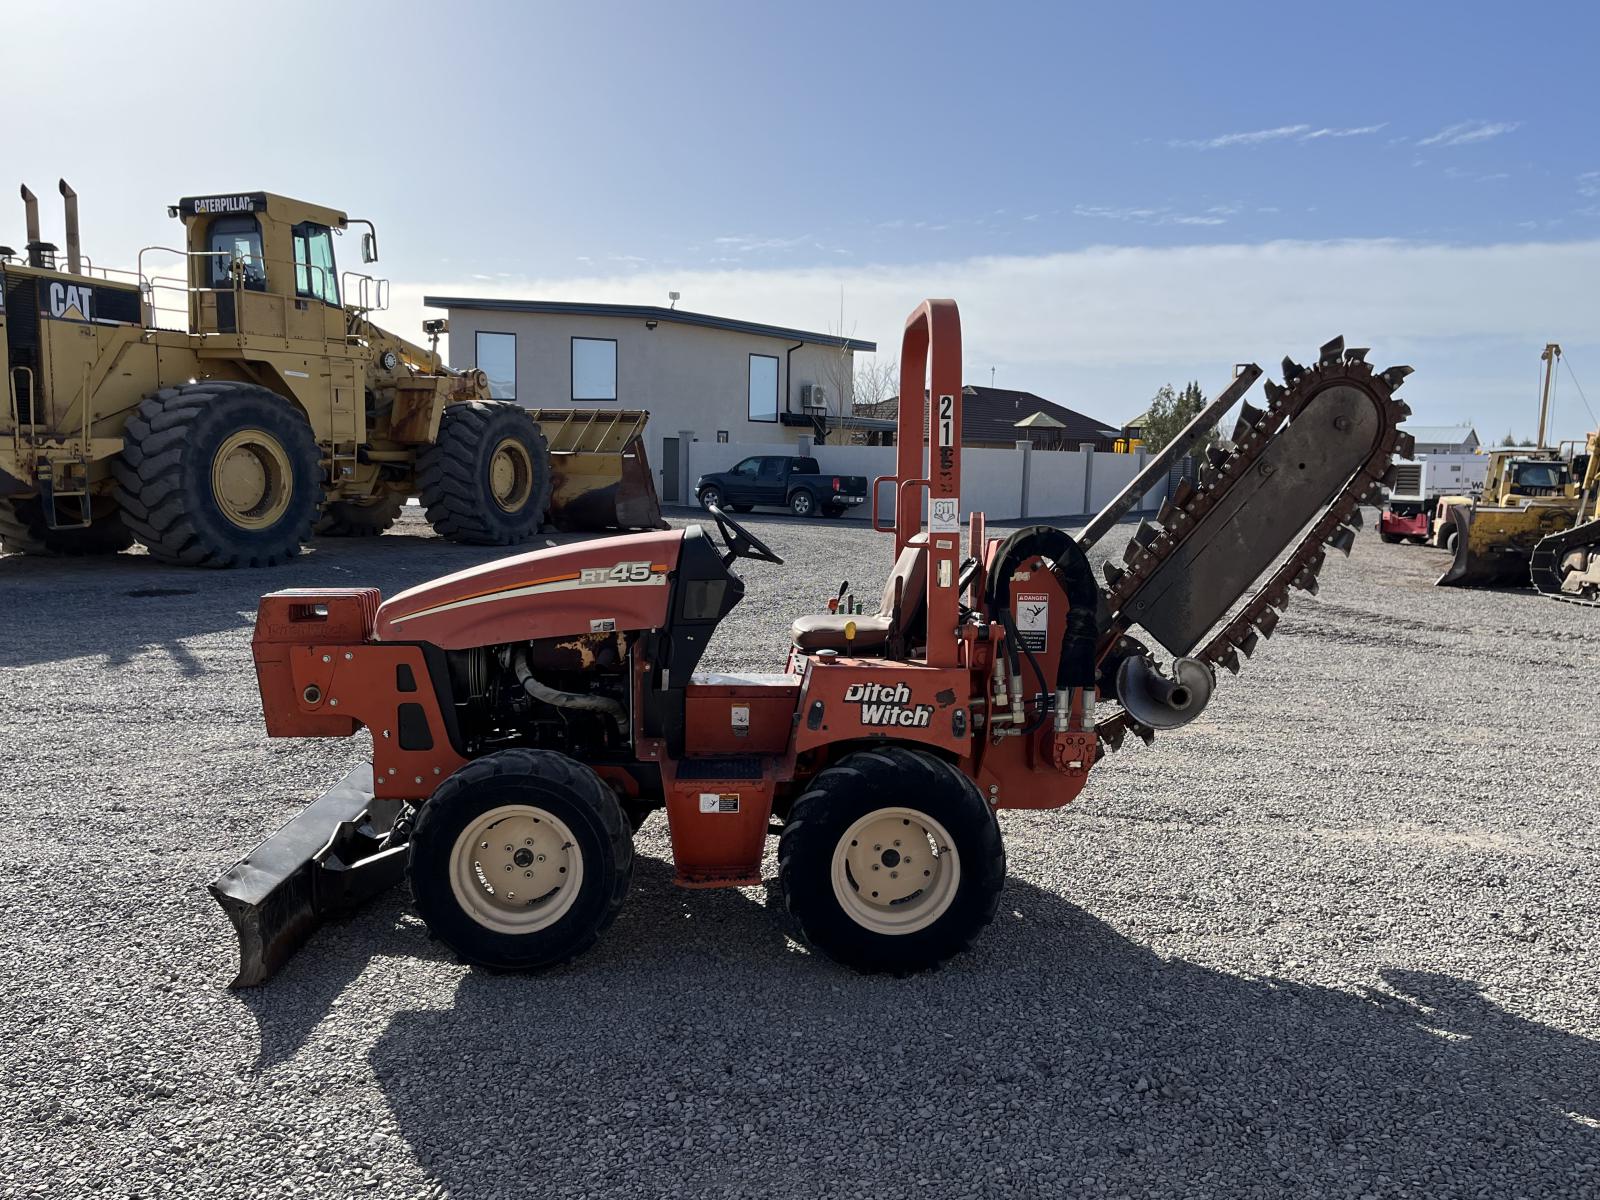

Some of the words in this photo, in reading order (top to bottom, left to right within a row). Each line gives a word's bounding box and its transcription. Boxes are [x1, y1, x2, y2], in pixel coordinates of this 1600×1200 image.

[49, 282, 92, 322] CAT
[844, 682, 910, 703] Ditch
[861, 704, 929, 726] Witch
